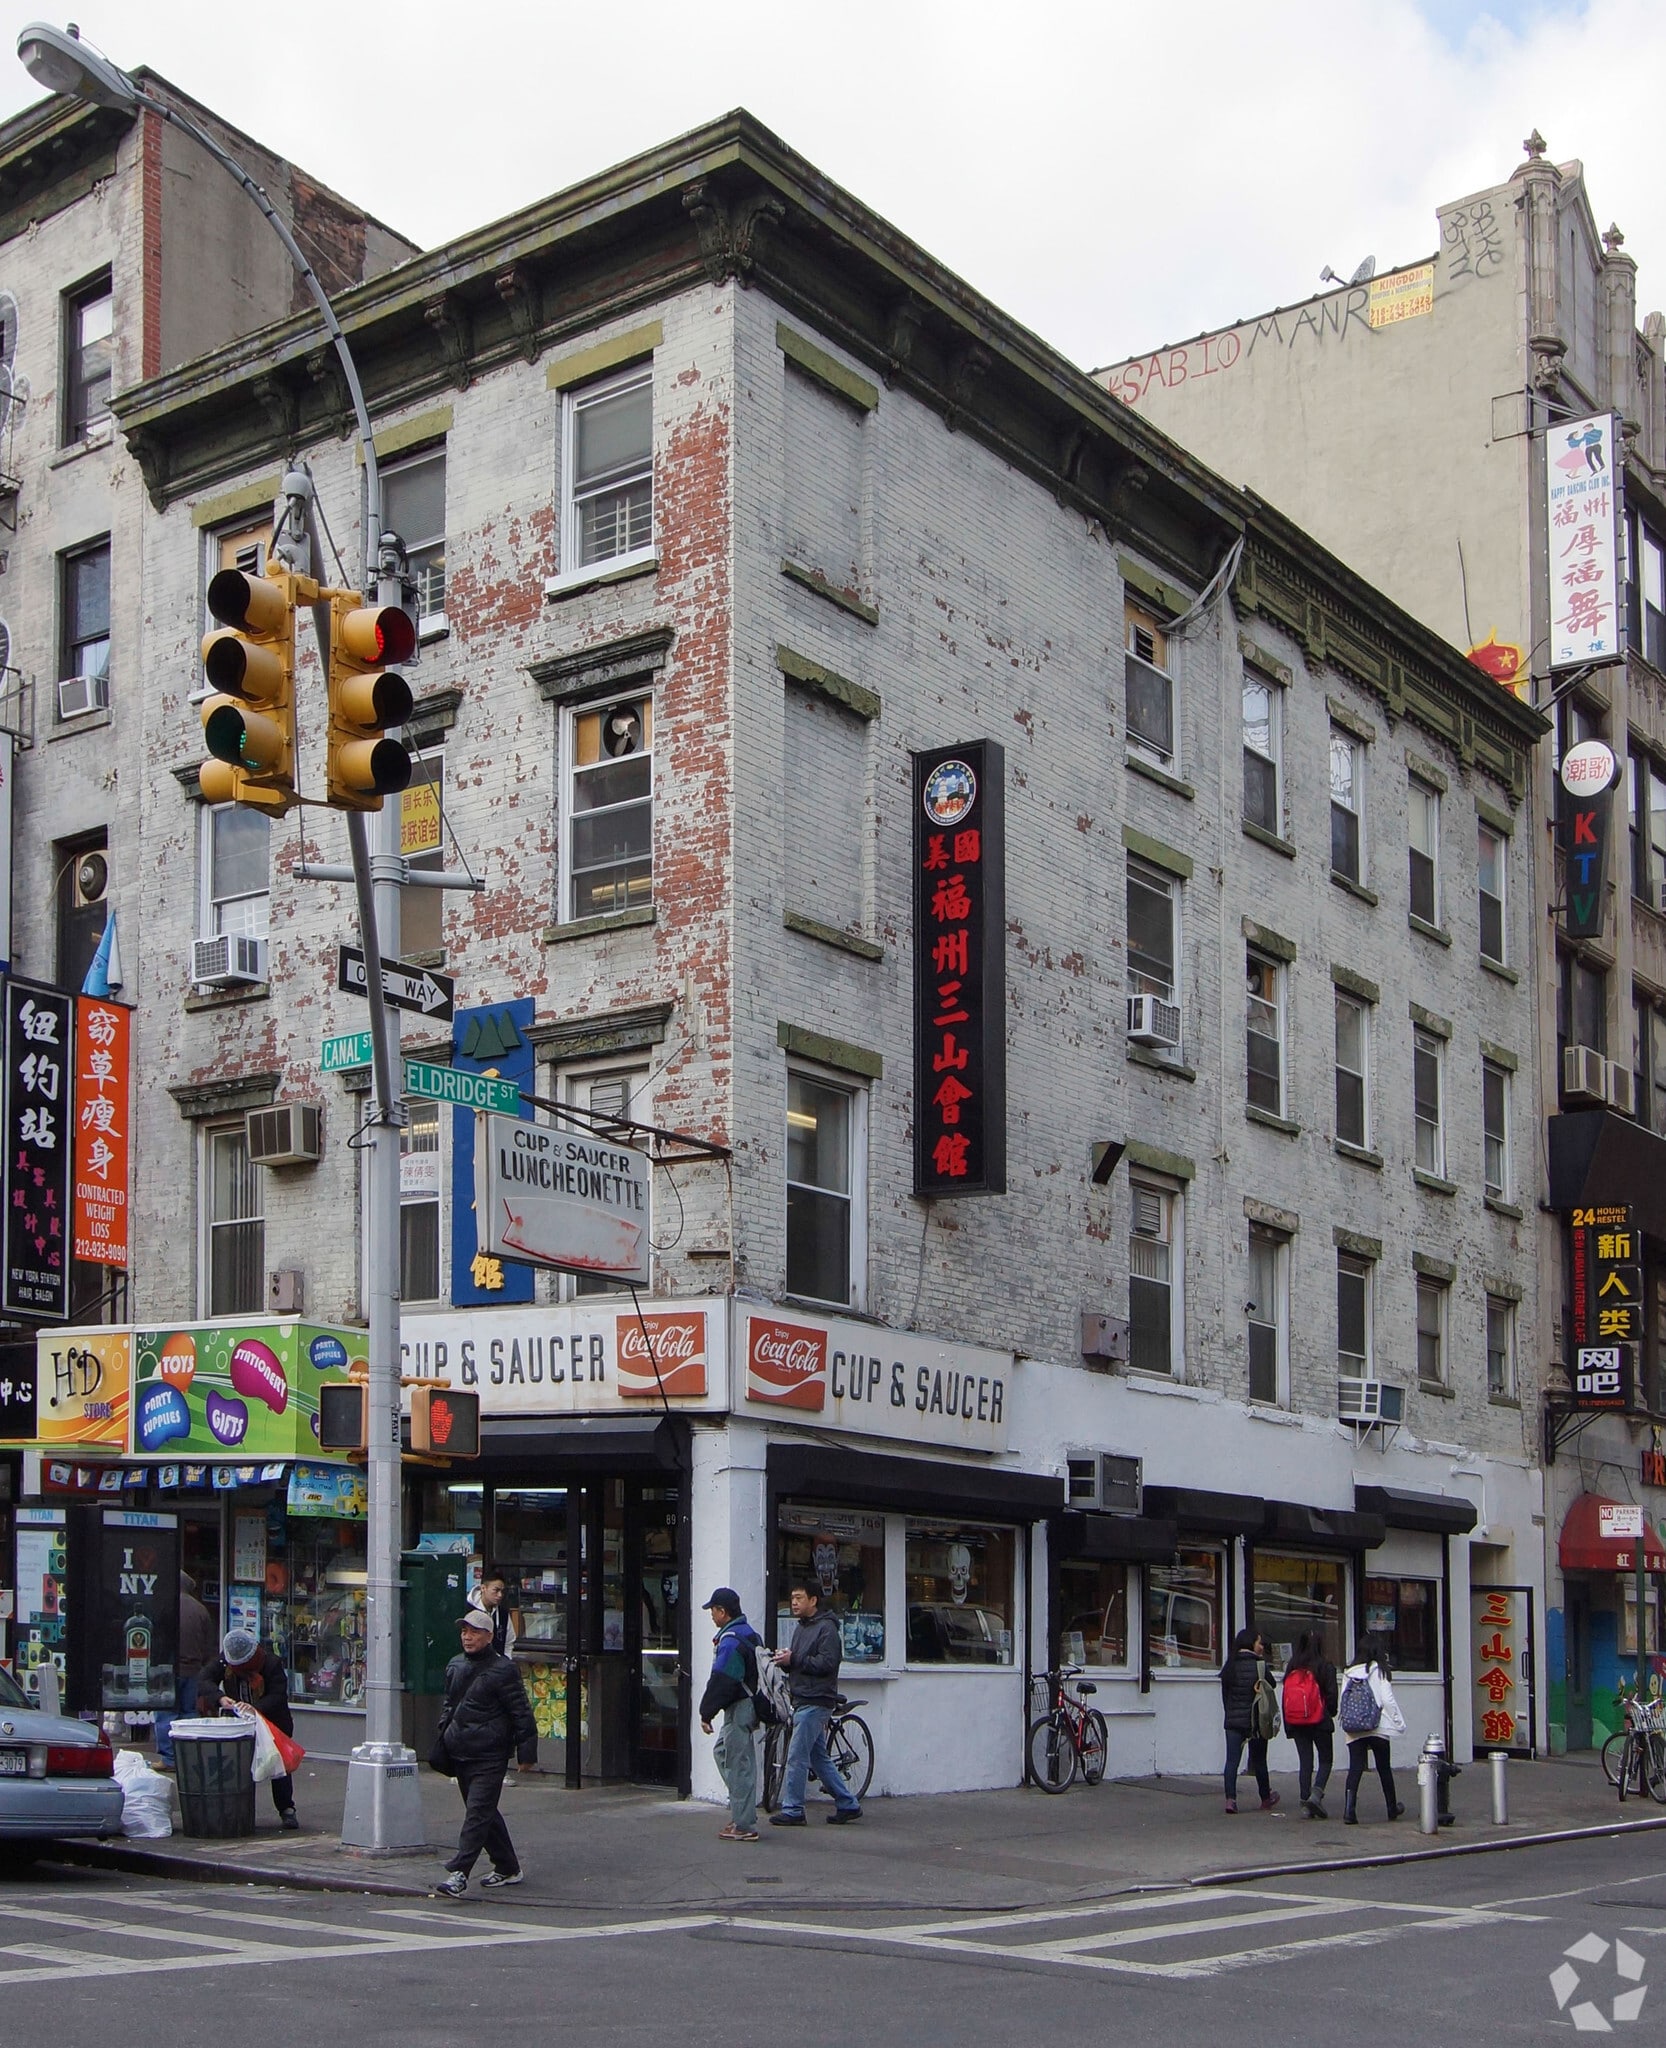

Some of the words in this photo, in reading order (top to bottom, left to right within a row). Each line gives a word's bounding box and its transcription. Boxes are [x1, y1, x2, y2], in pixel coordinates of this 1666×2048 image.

[1380, 270, 1423, 291] KINGDOM
[1551, 486, 1565, 500] HAPPY
[1567, 482, 1587, 497] DANCING
[1589, 477, 1600, 491] CLUB
[1560, 647, 1573, 660] 5
[1565, 755, 1611, 782] 潮歌
[923, 830, 980, 871] 美國
[1572, 811, 1598, 925] KTV
[356, 965, 389, 990] OE
[405, 978, 438, 1004] WAY
[932, 874, 972, 1177] 福州三山會館
[324, 1037, 361, 1068] CANAL
[407, 1065, 498, 1108] ELDRIDGE
[500, 1084, 515, 1100] ST
[514, 1129, 549, 1153] CUP
[553, 1144, 563, 1157] &
[565, 1143, 631, 1173] SAUCER
[501, 1149, 645, 1211] LUNCHEONETTE
[76, 1182, 125, 1206] CONTRACTED
[86, 1202, 116, 1222] WEIGHT
[1572, 1208, 1596, 1226] 24
[1597, 1206, 1627, 1215] HOURS
[1597, 1215, 1627, 1224] RESTEL
[91, 1221, 110, 1239] LOSS
[75, 1238, 126, 1262] 212-925-9090
[12, 1268, 23, 1280] NEW
[25, 1270, 39, 1284] YORK
[40, 1273, 61, 1286] STATION
[1598, 1233, 1630, 1337] 新人类
[18, 1286, 33, 1301] HAIR
[35, 1288, 54, 1302] SALON
[642, 1320, 659, 1330] Enjoy
[774, 1328, 790, 1340] Enjoy
[315, 1340, 335, 1350] PARTY
[621, 1325, 698, 1359] Coca-Cola
[754, 1333, 822, 1372] Coca-Cola
[161, 1355, 195, 1374] TOYS
[314, 1350, 341, 1362] SUPPLIES
[461, 1340, 478, 1384] &
[490, 1334, 605, 1385] SAUCER
[234, 1348, 288, 1399] STATIONERY
[1577, 1348, 1620, 1394] 网吧
[832, 1350, 881, 1402] CUP
[890, 1361, 905, 1408] &
[915, 1366, 1004, 1423] SAUCER
[84, 1403, 112, 1418] STORE
[144, 1391, 172, 1414] PARTY
[143, 1410, 181, 1437] SUPPLIES
[212, 1408, 244, 1438] GIFTS
[1643, 1451, 1666, 1486] PR
[29, 1509, 54, 1521] TITAN
[123, 1513, 158, 1526] TITAN
[1601, 1508, 1613, 1519] NO
[123, 1548, 133, 1569] I
[120, 1573, 158, 1595] NY
